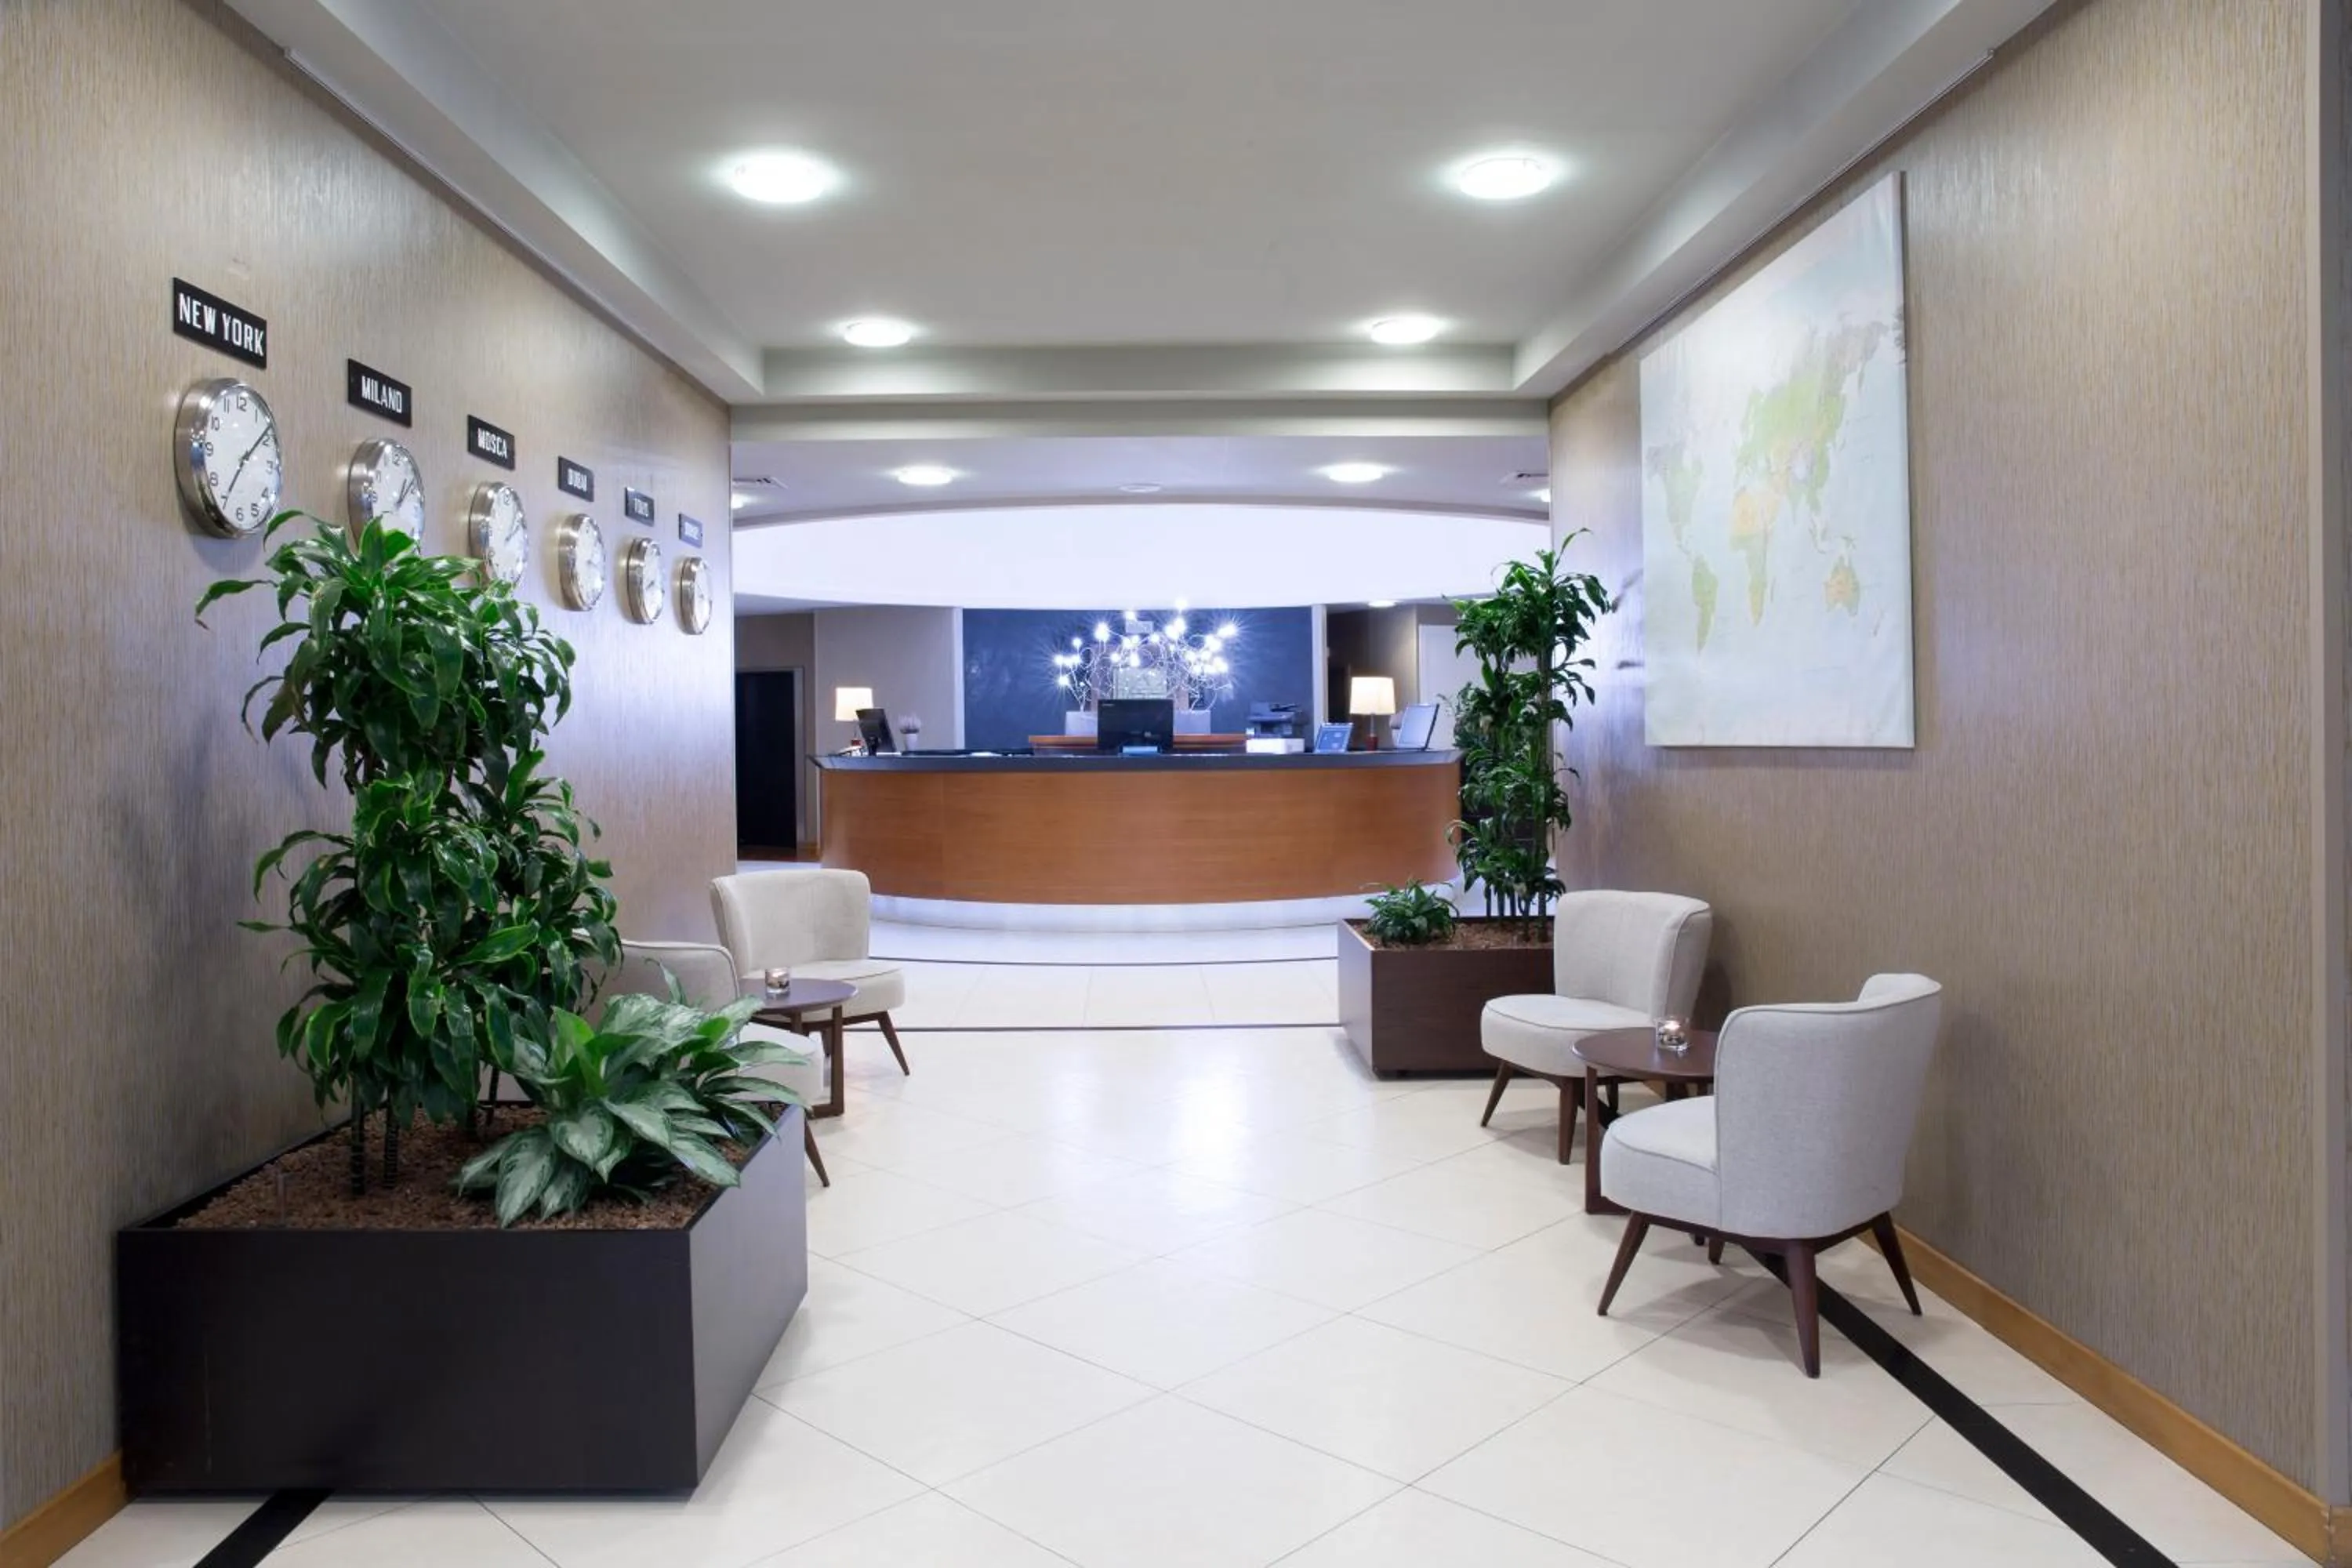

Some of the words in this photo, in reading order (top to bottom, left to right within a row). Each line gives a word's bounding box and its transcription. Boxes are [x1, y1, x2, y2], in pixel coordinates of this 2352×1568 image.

[180, 293, 216, 335] NEW
[222, 313, 264, 356] YORK
[361, 376, 402, 413] MILANO
[236, 395, 247, 413] 12
[211, 416, 220, 431] 10
[205, 441, 214, 457] 9
[477, 427, 508, 459] MOSCA
[266, 460, 274, 474] 3
[209, 471, 218, 487] 8
[261, 487, 269, 502] 4
[220, 495, 228, 510] 7
[251, 503, 260, 517] 5
[236, 507, 244, 522] 6
